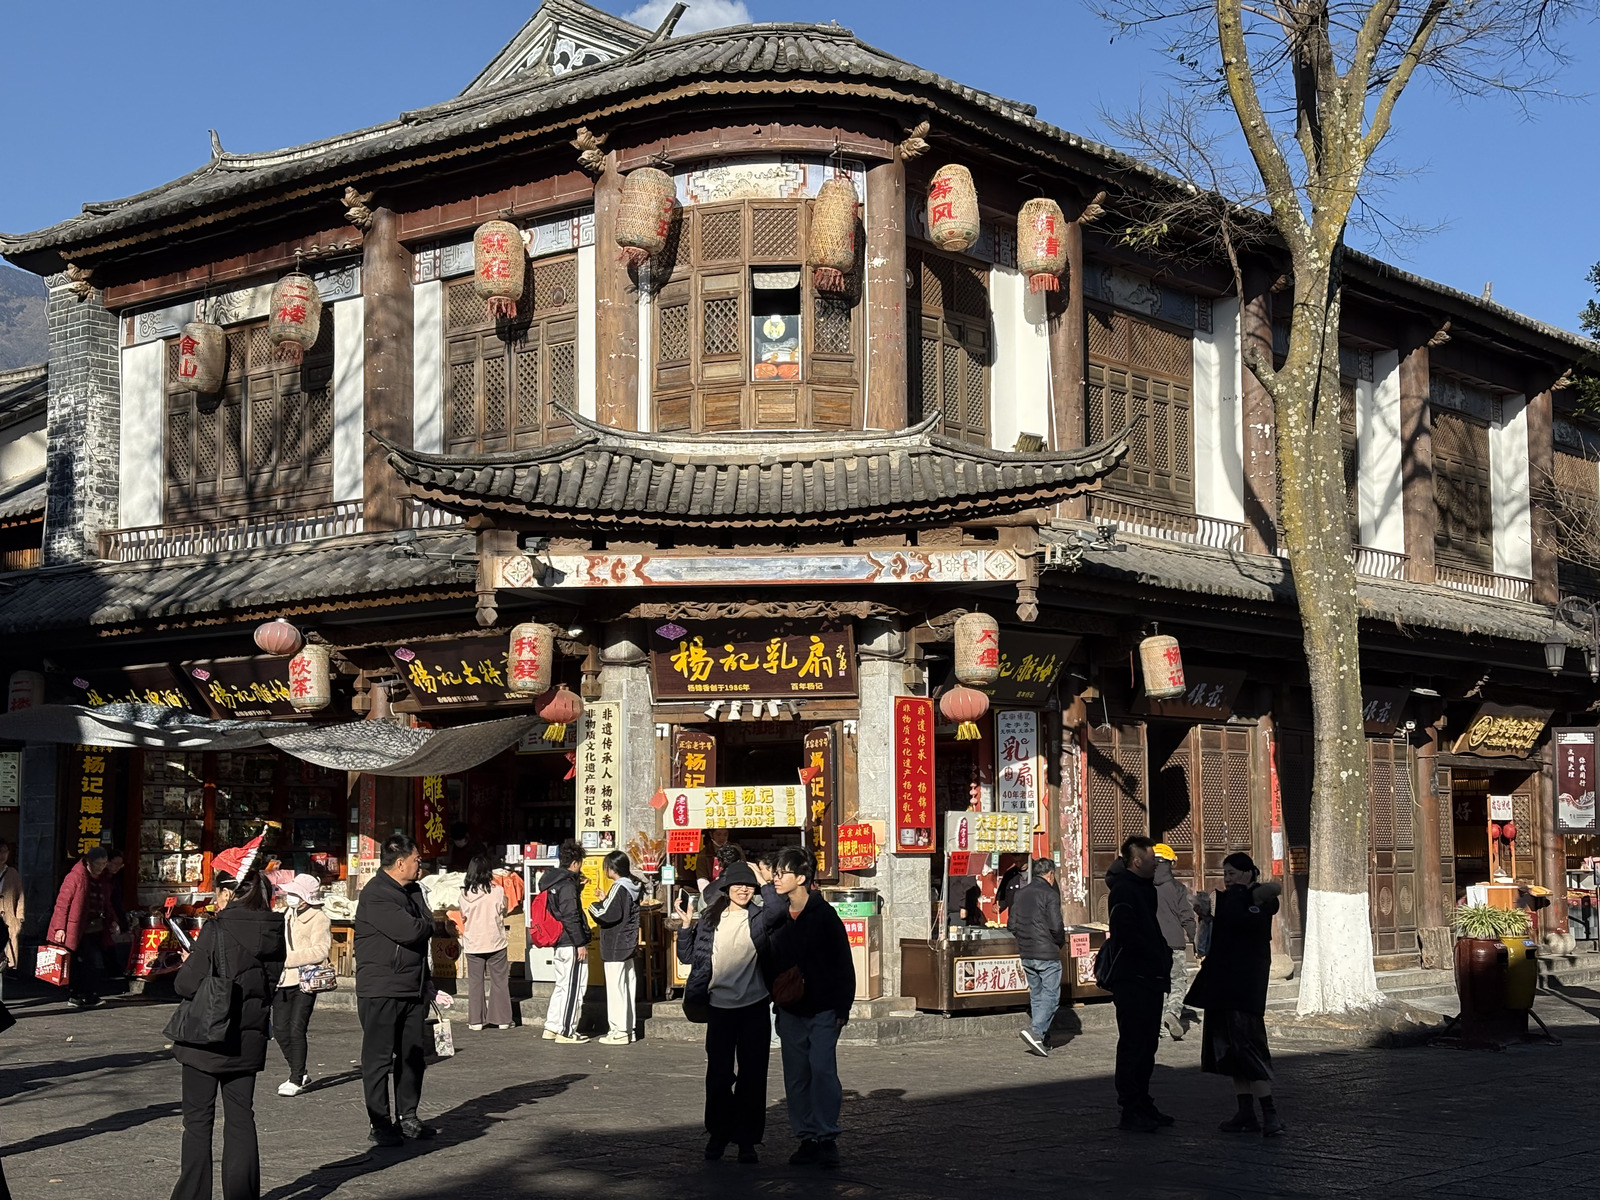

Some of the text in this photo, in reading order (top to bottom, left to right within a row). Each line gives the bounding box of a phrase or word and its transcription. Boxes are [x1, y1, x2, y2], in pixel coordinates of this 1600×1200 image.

[930, 176, 958, 227] 等风
[179, 335, 200, 378] 食山
[513, 635, 541, 681] 我爱
[976, 629, 999, 669] 大理
[1163, 646, 1184, 687] 杨记
[289, 656, 312, 698] 饮茶
[790, 682, 823, 690] 百年杨记
[679, 740, 713, 751] 正宗老字号
[805, 738, 829, 750] 正宗老字号
[902, 703, 914, 824] 非物质文化遗产杨记乳扇
[916, 704, 928, 825] 非遗传承人 杨锦香
[1000, 735, 1033, 789] 乳扇
[1567, 748, 1575, 778] 文明大理
[584, 708, 597, 828] 非物质文化遗产杨记乳扇
[600, 707, 613, 828] 非遗传承人 杨锦香
[1578, 756, 1586, 787] 你我同行
[78, 755, 106, 855] 杨记雕梅酒
[422, 775, 447, 846] 雕梅
[676, 796, 687, 824] 老字号
[705, 788, 774, 805] 大理杨记
[811, 751, 826, 873] 杨记烤乳扇
[1002, 790, 1035, 800] 40年老店
[1002, 800, 1035, 810] 厂家直销
[976, 966, 1018, 991] 烤乳扇
